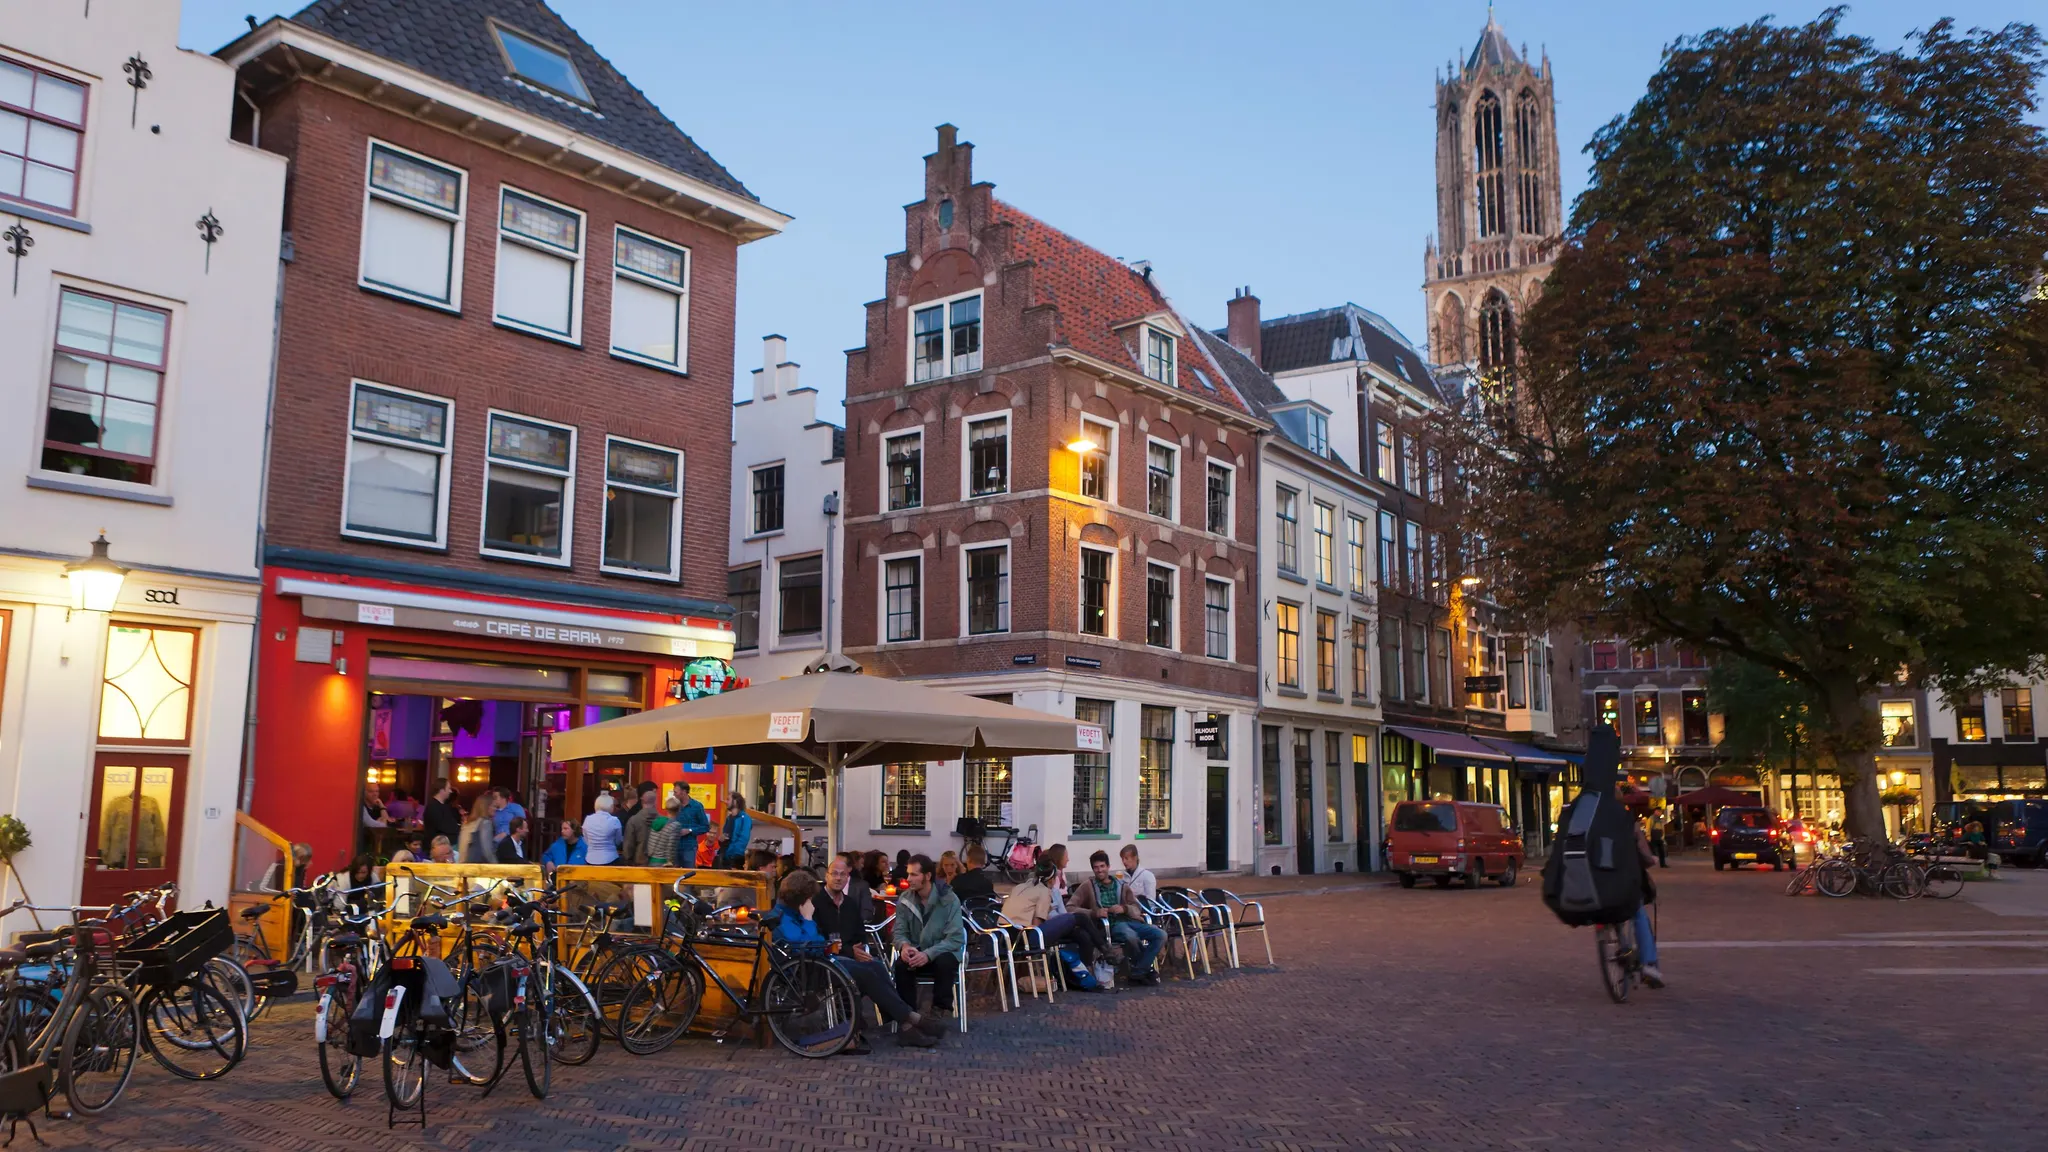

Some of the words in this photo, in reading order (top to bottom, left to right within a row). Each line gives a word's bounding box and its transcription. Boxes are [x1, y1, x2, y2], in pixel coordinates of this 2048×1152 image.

[534, 626, 557, 640] DE
[773, 715, 801, 726] VEDETT
[1078, 727, 1101, 738] VEDETT
[1194, 727, 1218, 735] SILHOUET
